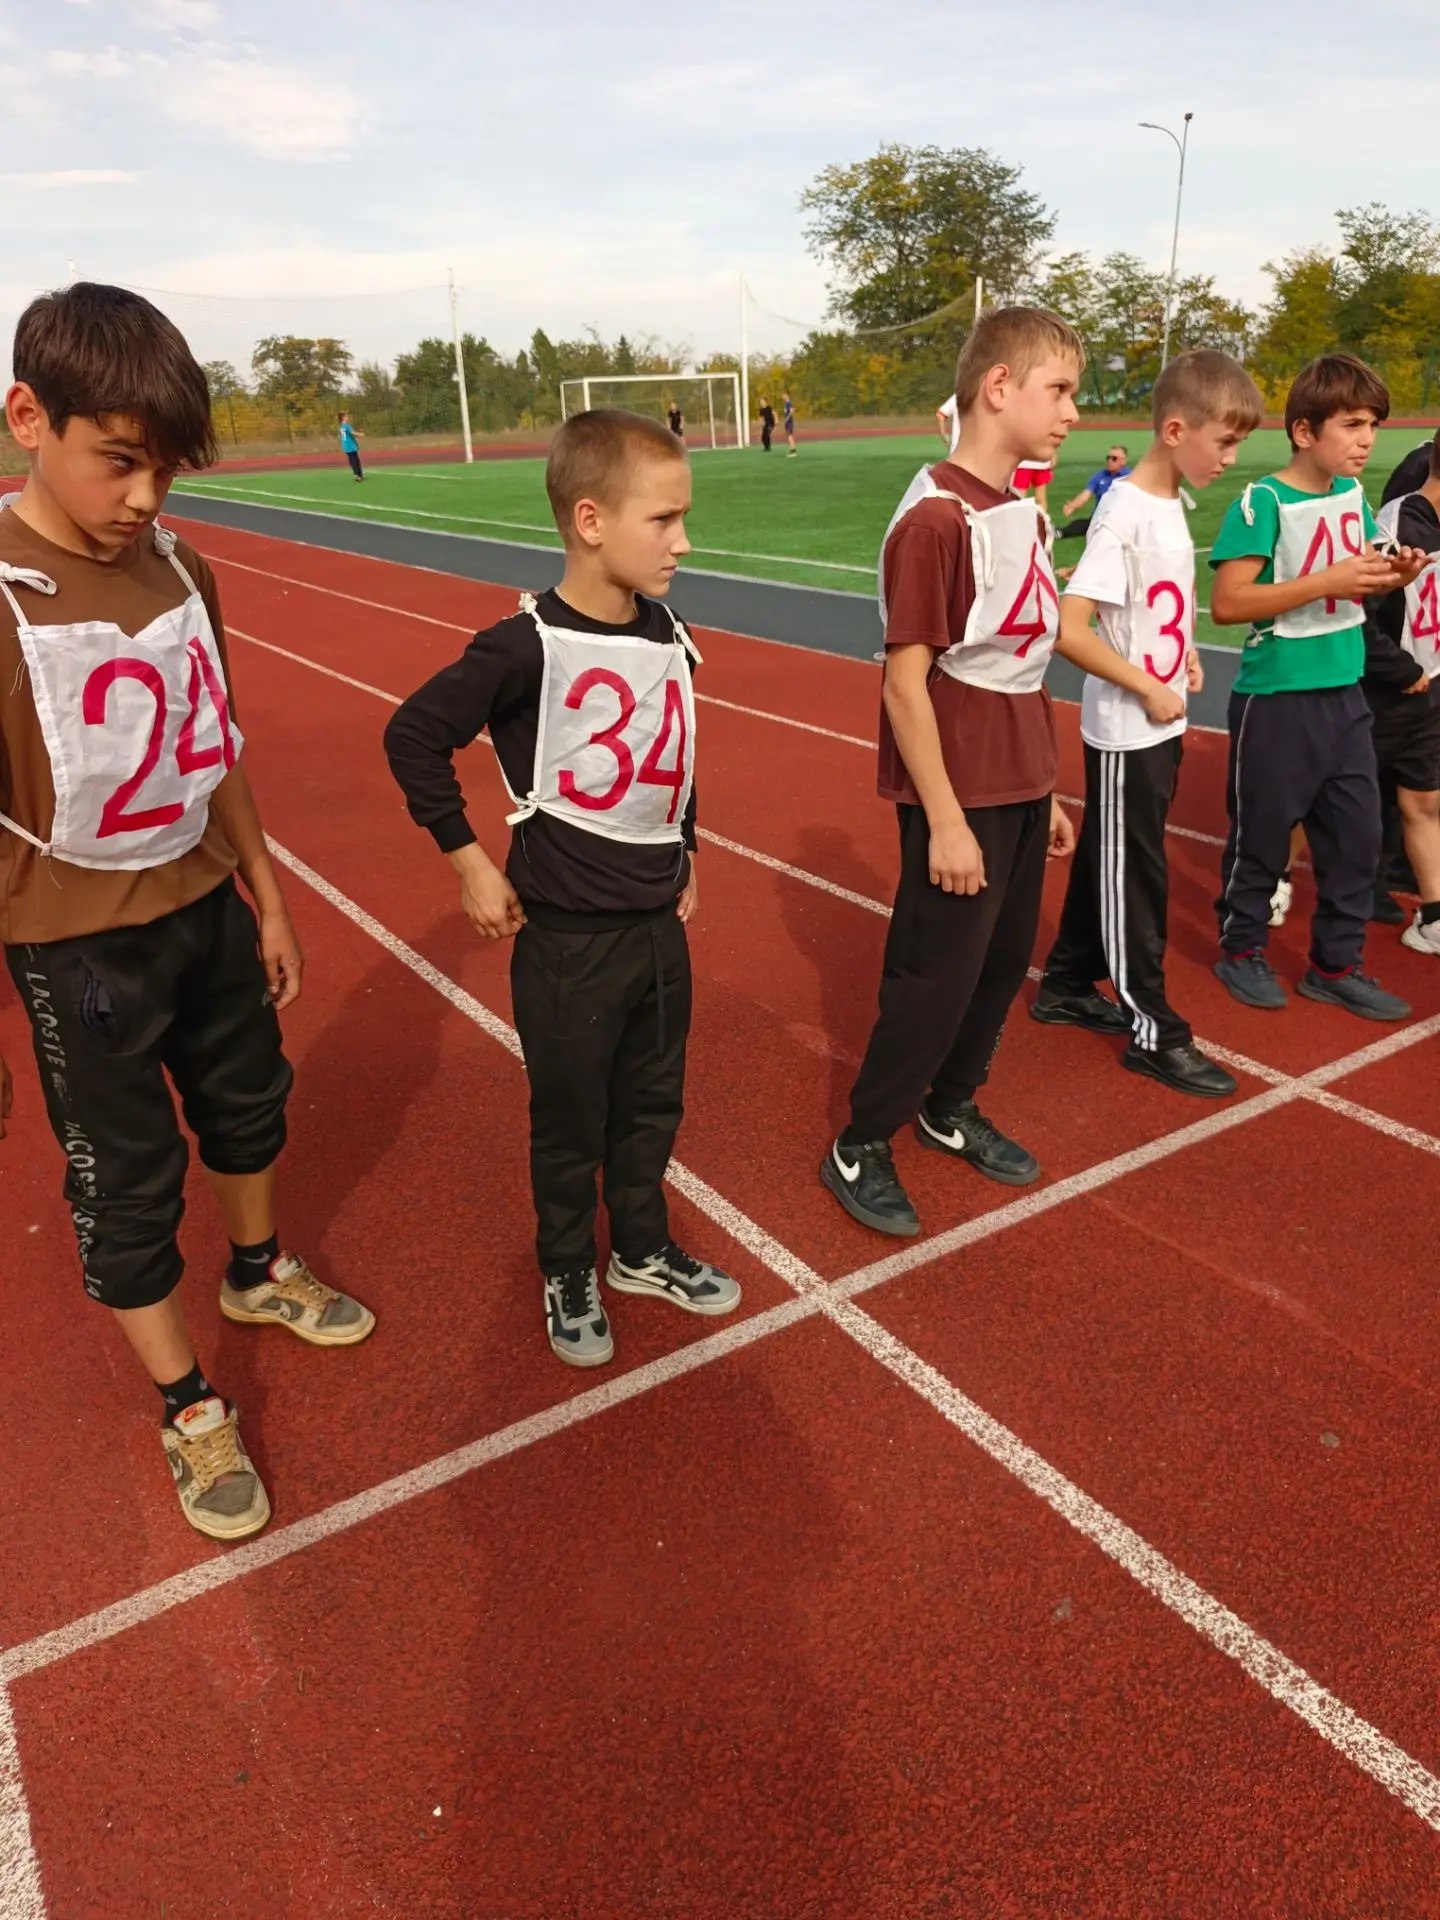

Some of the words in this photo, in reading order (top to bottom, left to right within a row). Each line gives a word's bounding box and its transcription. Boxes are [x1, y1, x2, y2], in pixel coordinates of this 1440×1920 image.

[82, 636, 235, 839] 24
[558, 667, 687, 823] 34
[26, 971, 66, 1068] LACOSTE
